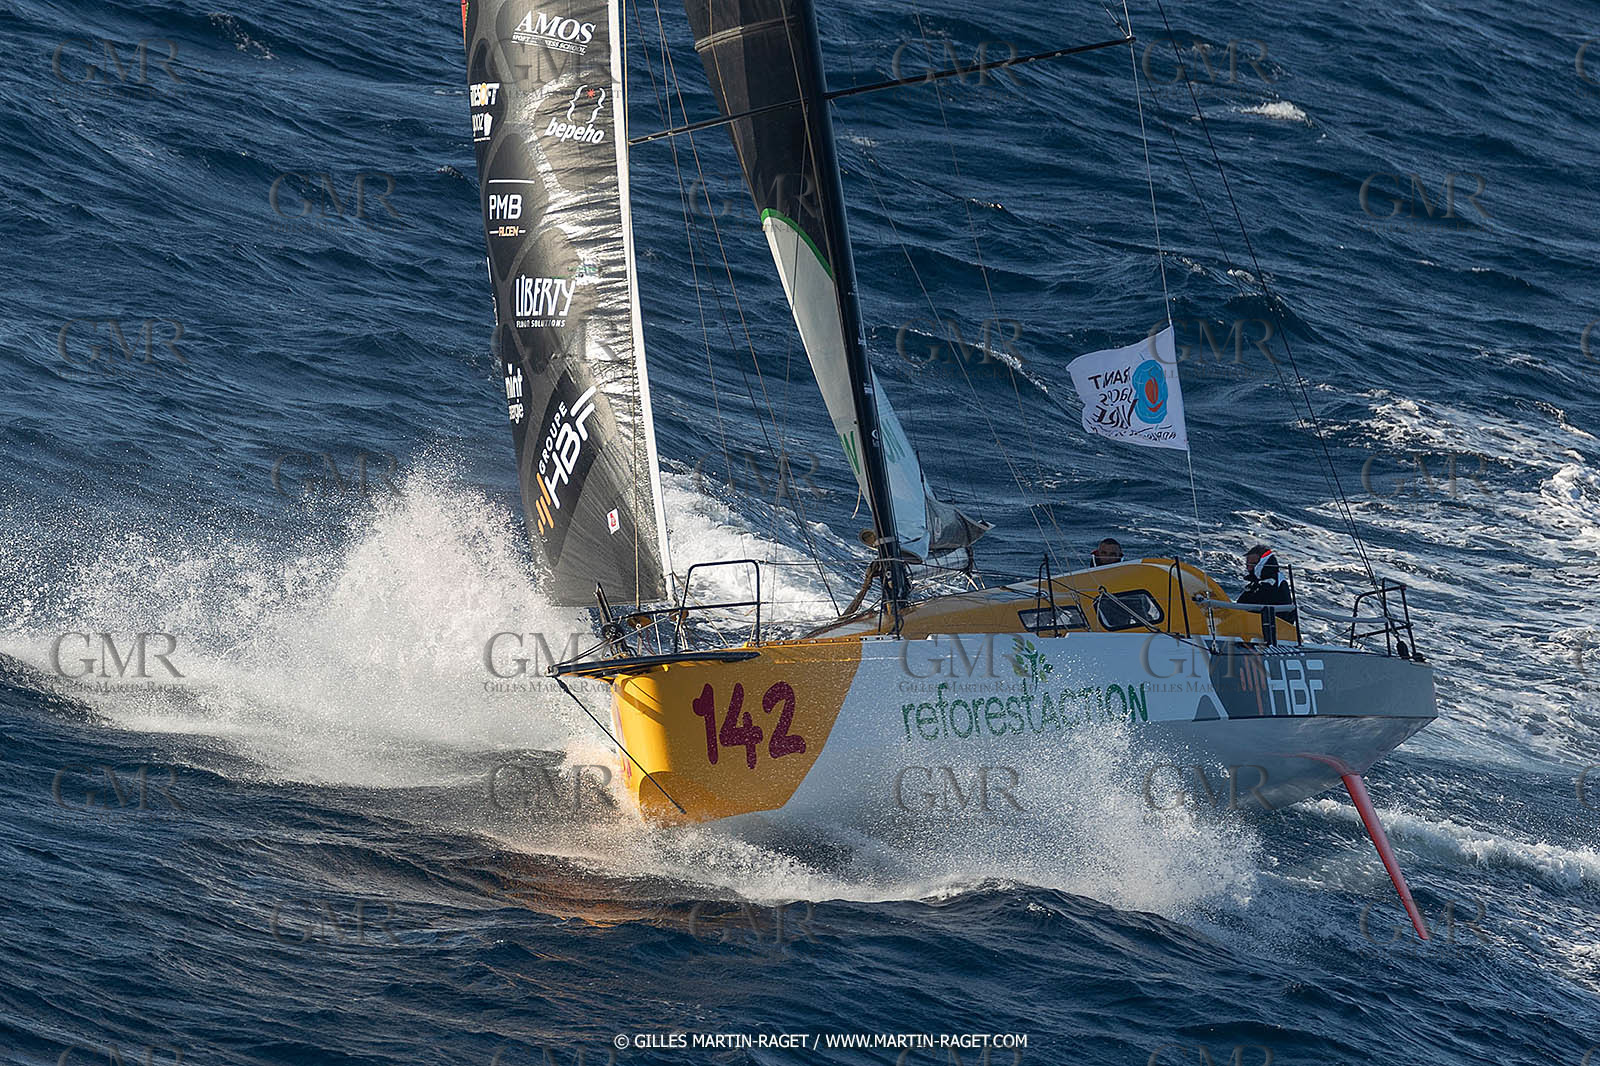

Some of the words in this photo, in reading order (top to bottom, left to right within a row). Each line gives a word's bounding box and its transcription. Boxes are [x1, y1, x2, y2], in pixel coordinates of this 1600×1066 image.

[515, 10, 597, 45] AMOS
[544, 117, 605, 144] bepeho
[489, 194, 522, 220] PMB
[515, 274, 577, 317] LIBERTY
[531, 319, 566, 328] SOLUTIONS
[538, 401, 568, 475] GROUPE
[545, 385, 597, 510] HBF
[1264, 659, 1325, 716] HBF
[692, 681, 807, 769] 142
